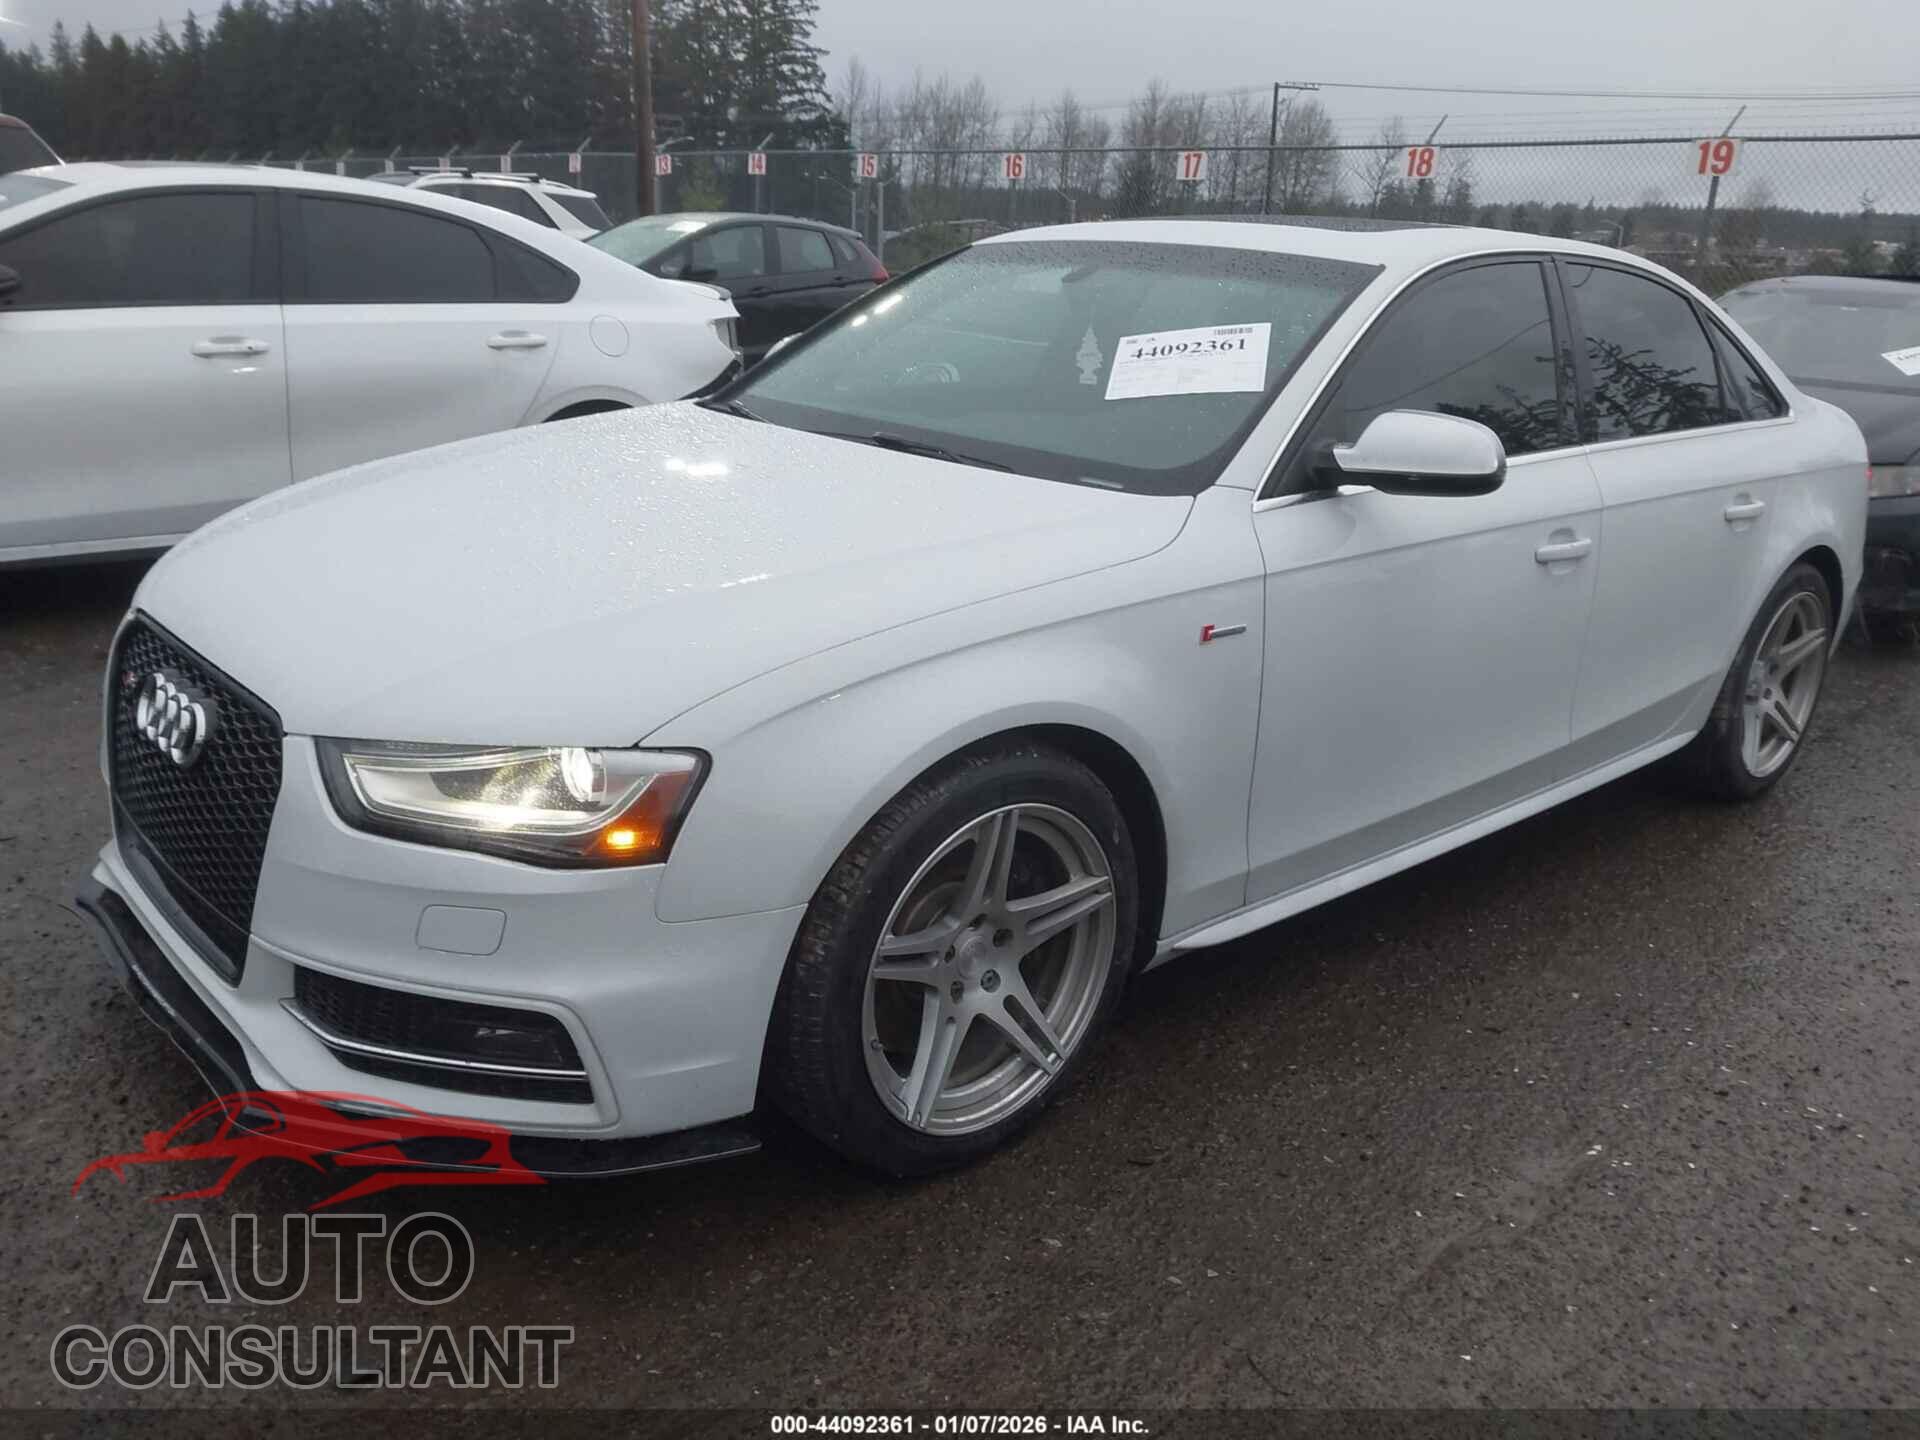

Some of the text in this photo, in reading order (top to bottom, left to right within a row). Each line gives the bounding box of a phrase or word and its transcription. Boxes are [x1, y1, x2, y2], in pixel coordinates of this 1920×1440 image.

[861, 153, 875, 176] 15
[1005, 154, 1023, 178] 16
[1184, 152, 1203, 178] 17
[1407, 147, 1435, 177] 18
[1697, 140, 1735, 175] 19
[1130, 337, 1248, 359] 44092361
